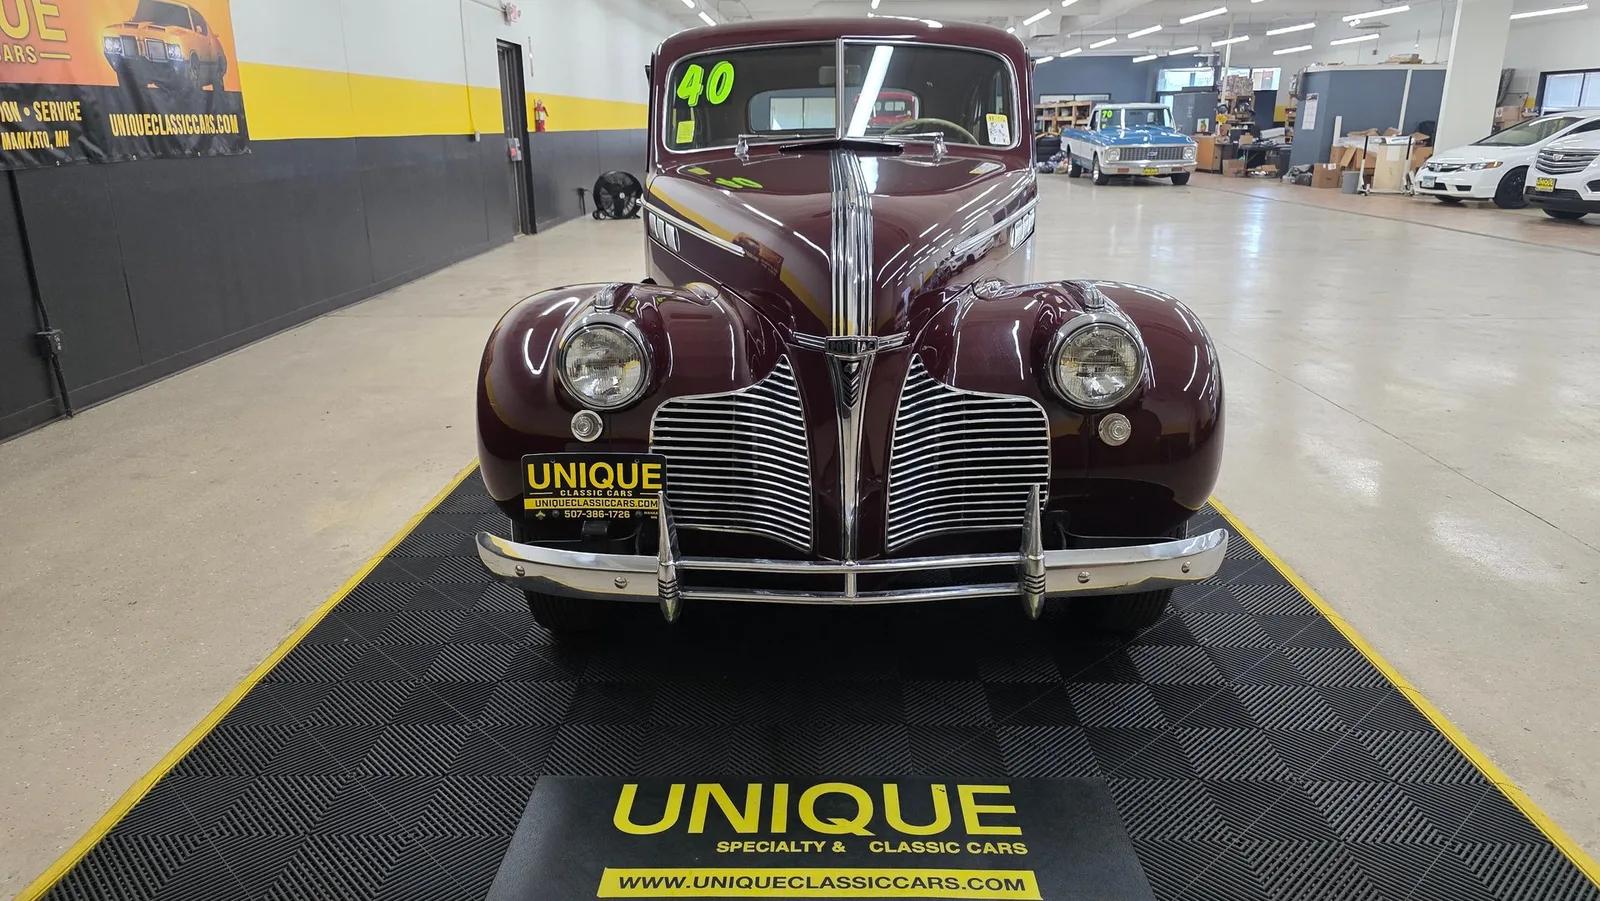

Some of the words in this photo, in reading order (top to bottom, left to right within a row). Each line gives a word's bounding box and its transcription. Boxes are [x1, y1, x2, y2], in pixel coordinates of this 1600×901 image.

[0, 44, 37, 63] ARS
[677, 60, 735, 107] 40
[33, 101, 82, 122] SERVICE
[1101, 110, 1113, 119] 70
[109, 113, 239, 137] UNIQUECLASSICCARS.COM
[1, 130, 53, 150] MANKATO,
[55, 130, 70, 147] MN
[527, 461, 663, 490] UNIQUE
[560, 489, 603, 497] CLASSIC
[606, 489, 633, 497] CARS
[535, 499, 658, 508] UNIQUECLASSICCARS.COM
[564, 510, 630, 519] 507-386-1726
[613, 782, 1023, 836] UNIQUE
[716, 840, 826, 853] SPECIALTY
[831, 841, 847, 853] &
[869, 841, 961, 854] CLASSIC
[966, 841, 1029, 855] CARS
[619, 876, 1026, 891] WWW.UNIQUECLASSICCARS.COM
